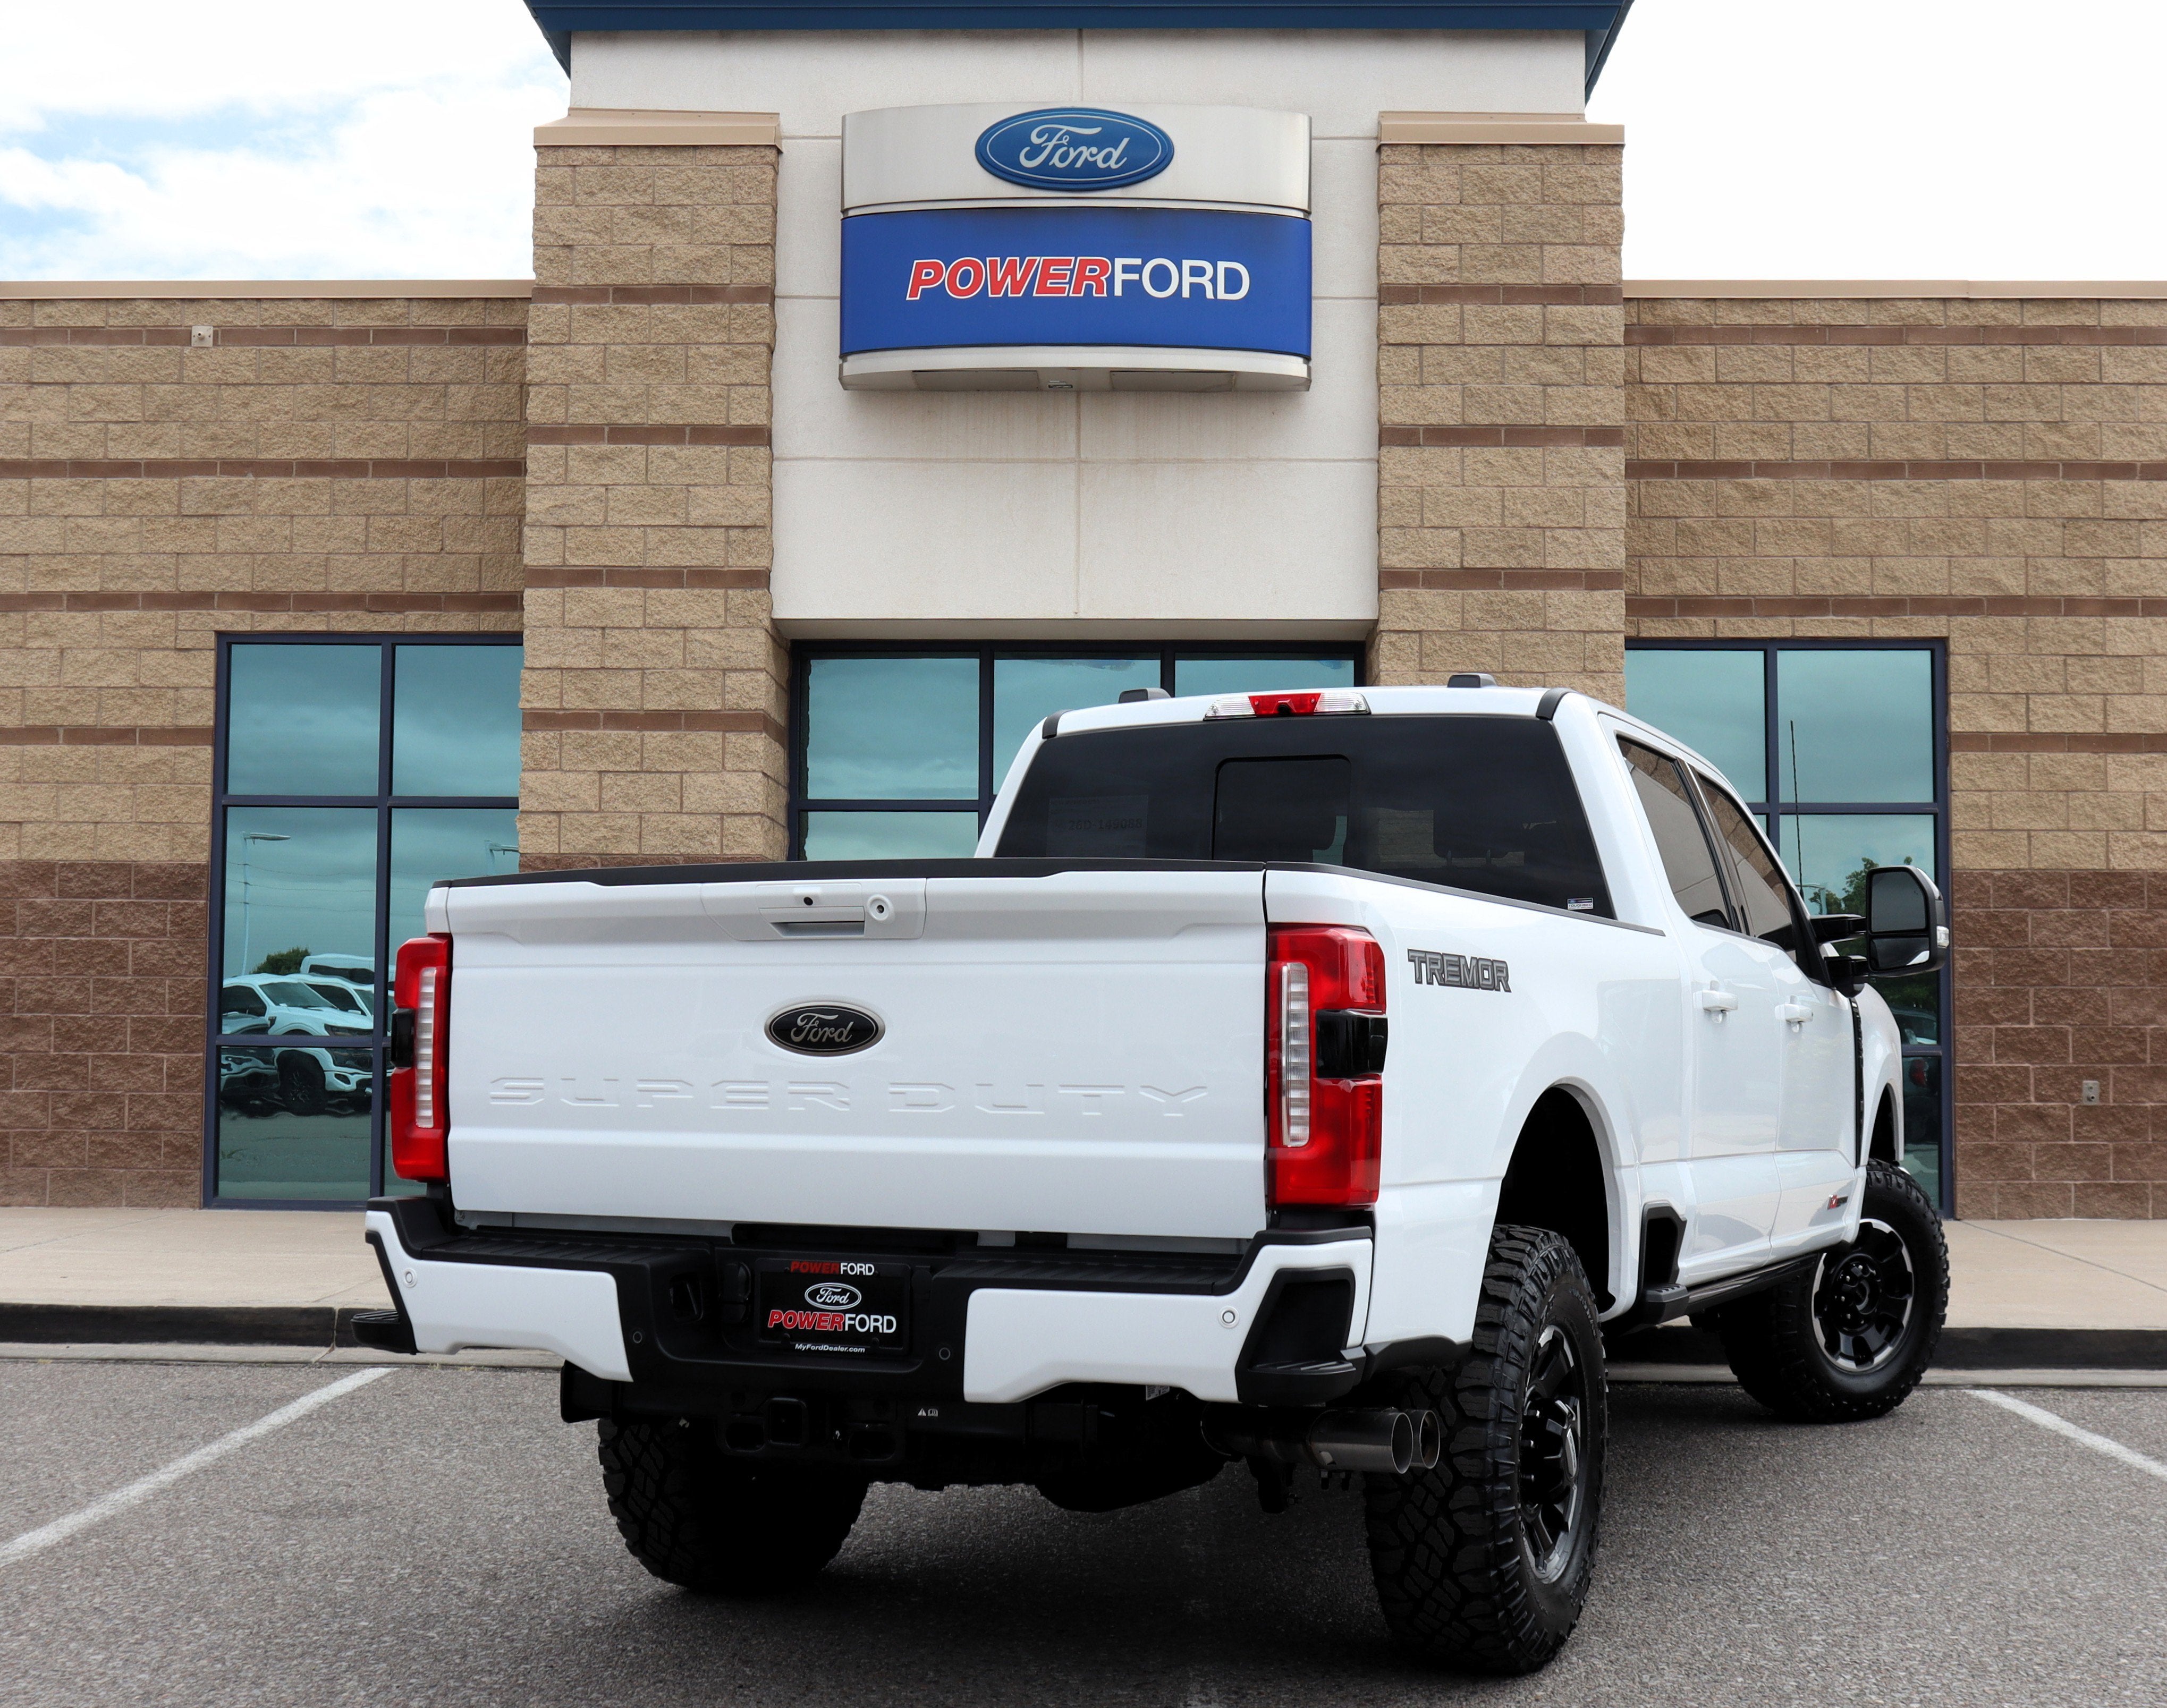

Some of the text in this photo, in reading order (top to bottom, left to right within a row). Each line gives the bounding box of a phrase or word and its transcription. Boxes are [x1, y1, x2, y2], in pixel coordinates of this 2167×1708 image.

[1019, 124, 1130, 169] Ford
[1407, 948, 1512, 993] TREMOR
[790, 1013, 853, 1043] Ford
[490, 1077, 1208, 1117] SUPER DUTY
[816, 1287, 850, 1304] Ford
[794, 1343, 865, 1353] MyFordDealer.com
